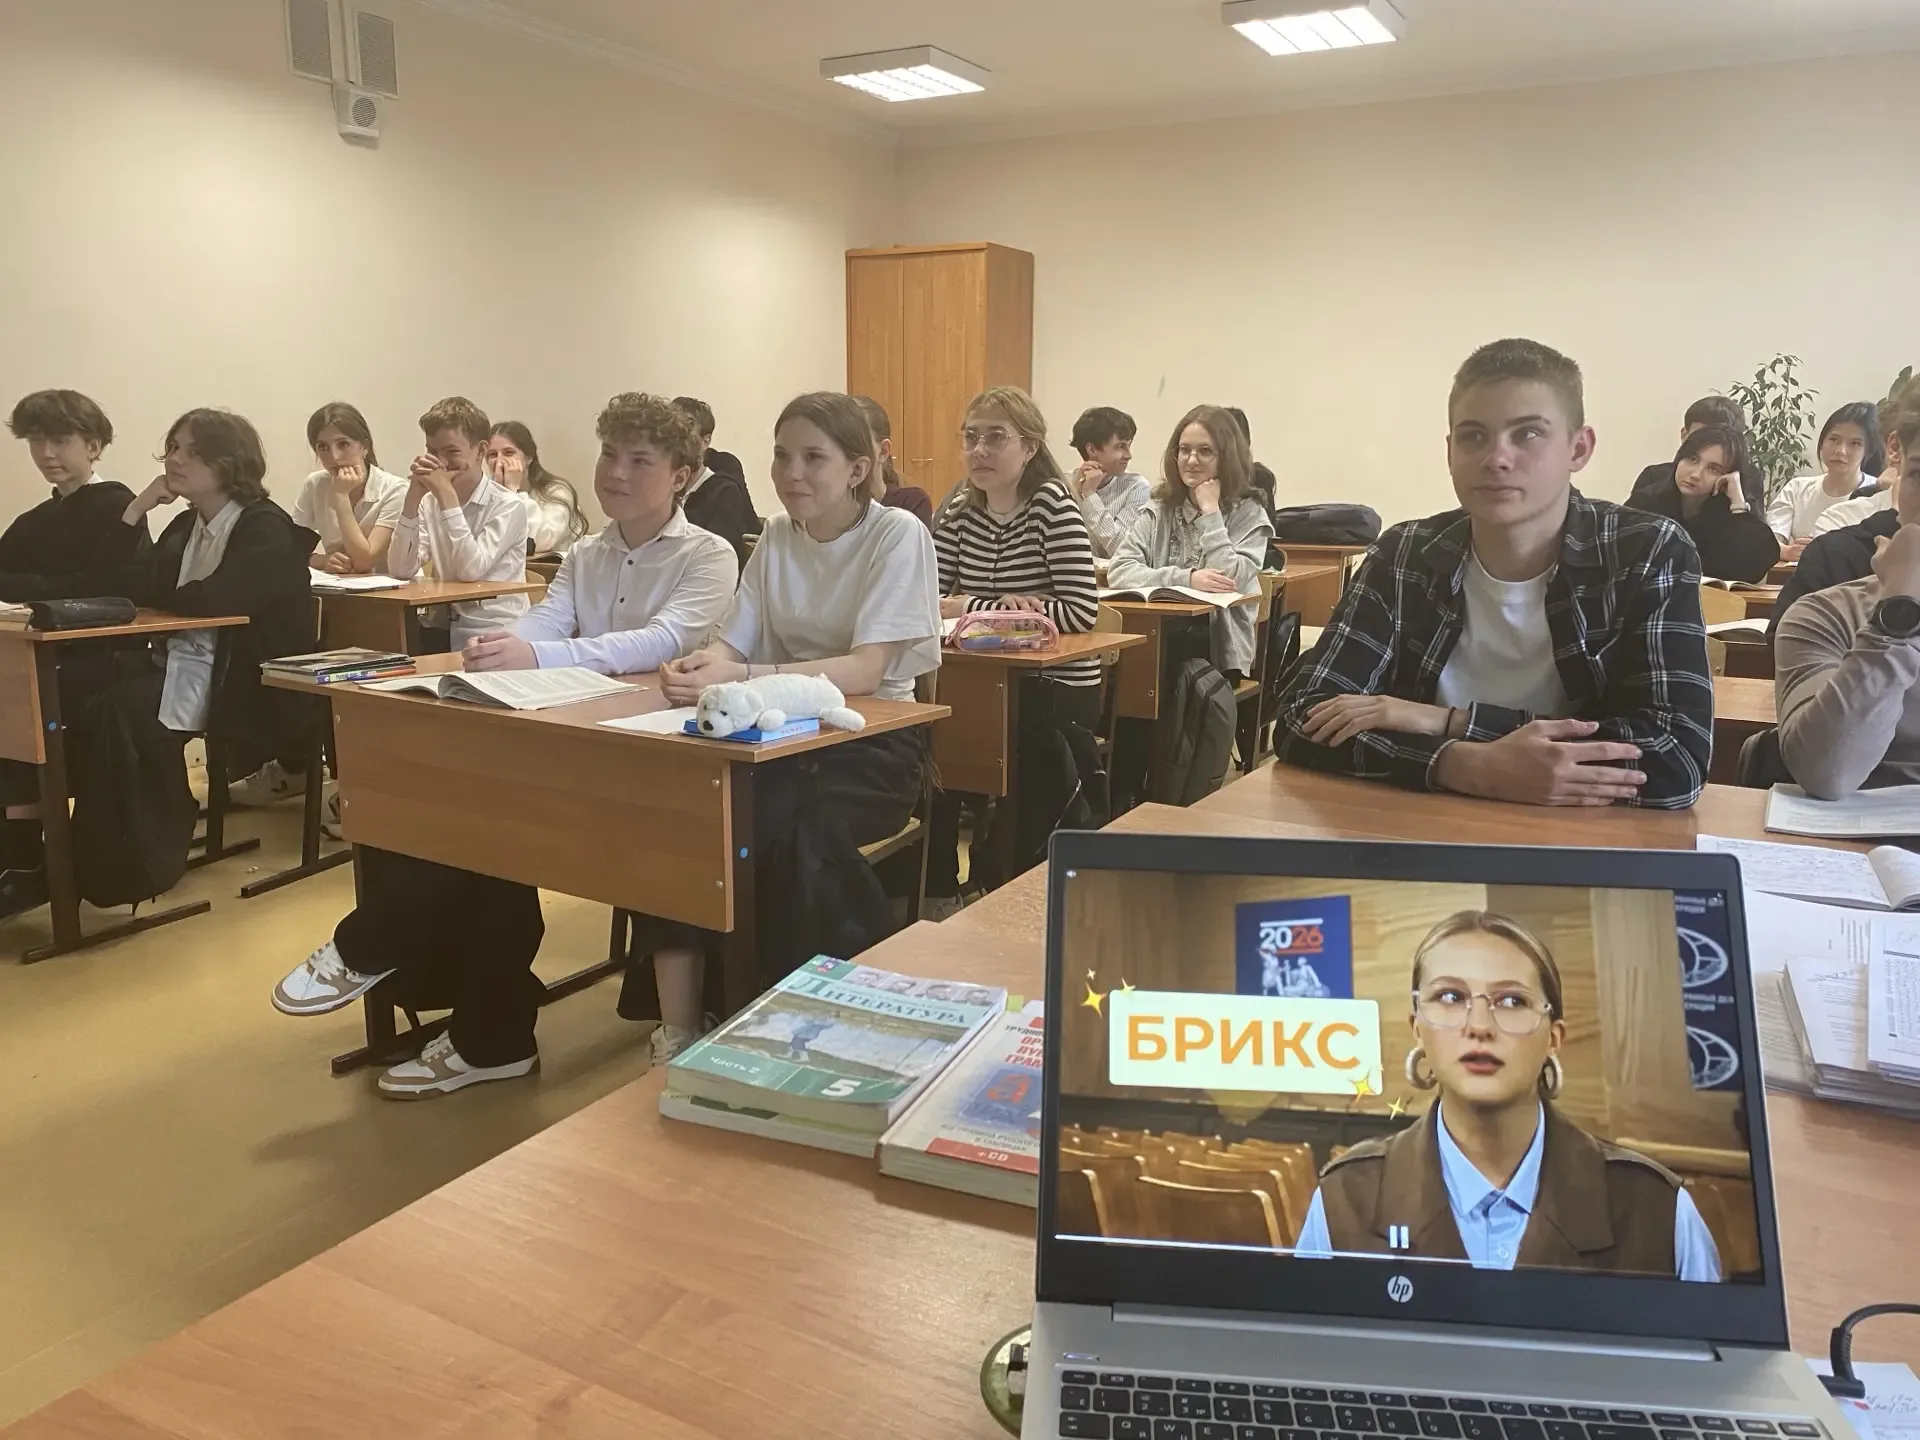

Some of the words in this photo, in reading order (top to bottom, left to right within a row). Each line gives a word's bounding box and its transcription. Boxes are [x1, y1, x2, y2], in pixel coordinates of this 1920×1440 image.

[1259, 925, 1324, 950] 2026
[1021, 1035, 1044, 1046] ОР
[1127, 1014, 1361, 1071] БРИКС
[747, 1066, 761, 1074] 2
[820, 1078, 863, 1097] 5
[1390, 1275, 1411, 1303] hp
